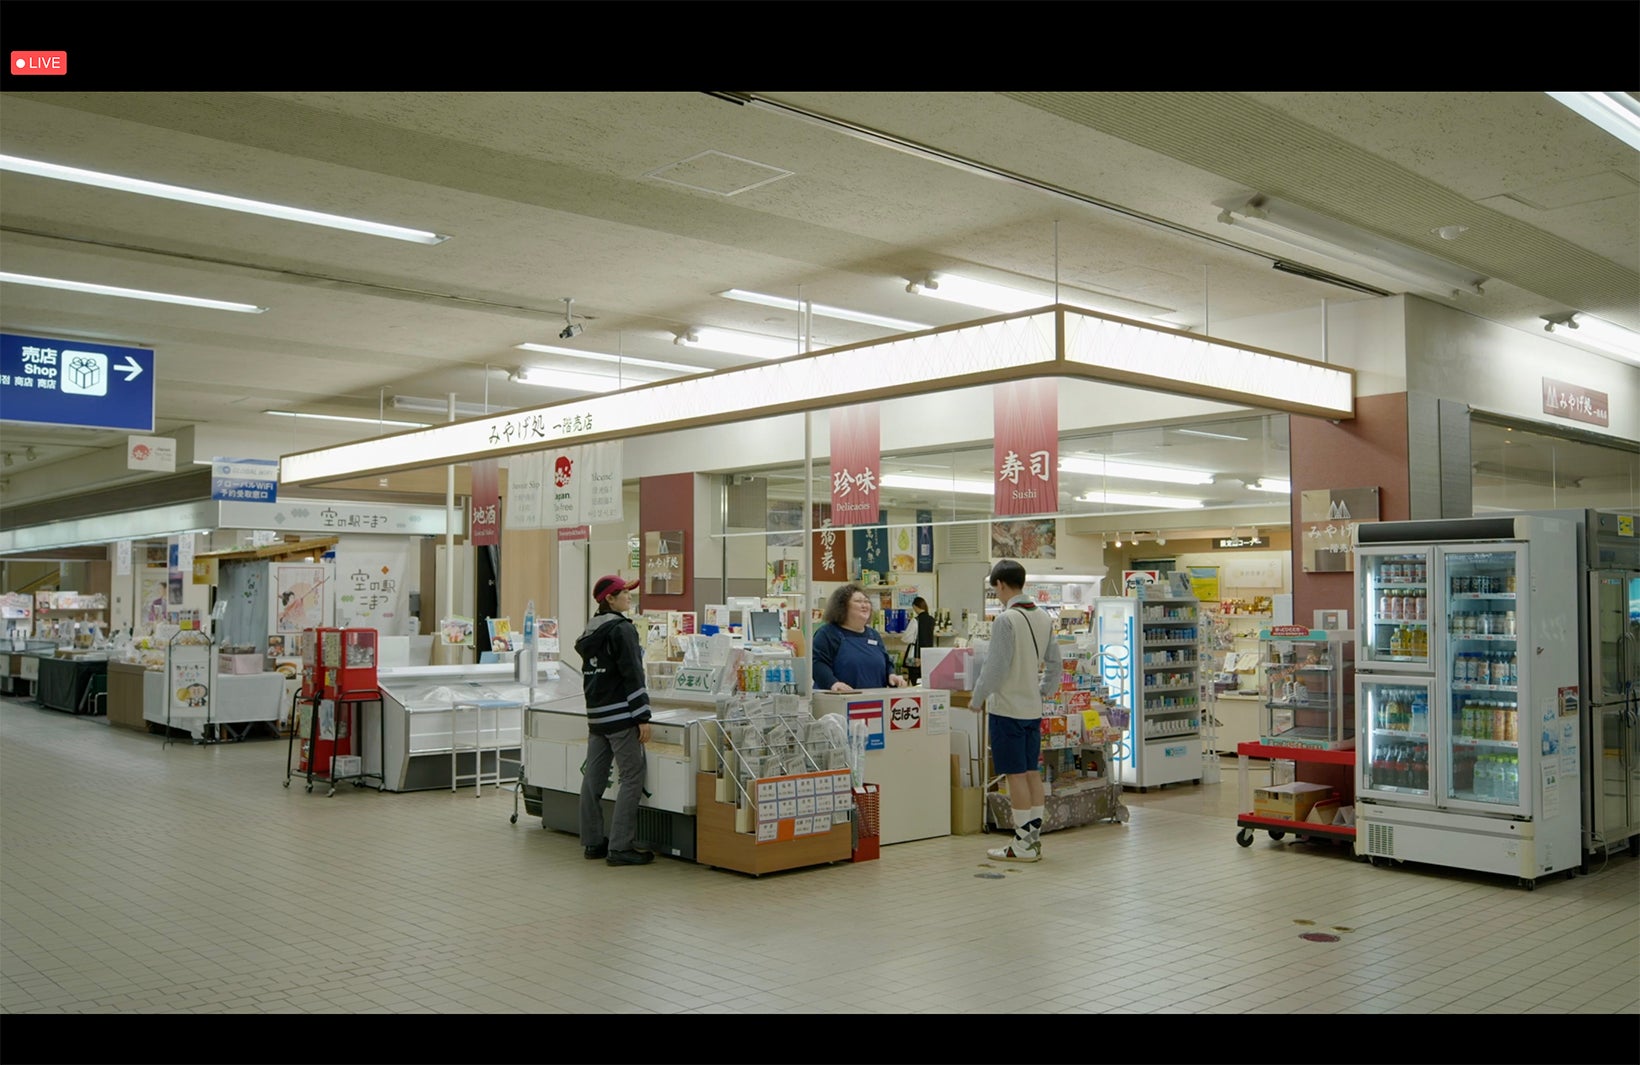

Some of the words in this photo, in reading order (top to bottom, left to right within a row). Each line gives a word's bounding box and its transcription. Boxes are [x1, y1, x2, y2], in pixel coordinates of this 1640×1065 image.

[22, 346, 58, 365] 売店
[24, 364, 58, 378] Shop
[0, 375, 10, 385] 점
[1560, 392, 1592, 416] みやげ処
[488, 415, 545, 444] みやげ処
[552, 413, 593, 434] 一階売店
[999, 450, 1050, 485] 寿司
[833, 467, 876, 498] 珍味
[1012, 489, 1037, 500] Sushi
[472, 504, 497, 525] 地酒
[836, 502, 871, 512] Delicacies
[320, 507, 388, 528] 空の駅こまつ
[1308, 523, 1353, 539] みやげ
[648, 556, 679, 568] みやげ処
[351, 569, 396, 593] 空の駅
[360, 594, 389, 610] こまつ
[892, 707, 919, 721] たばこ
